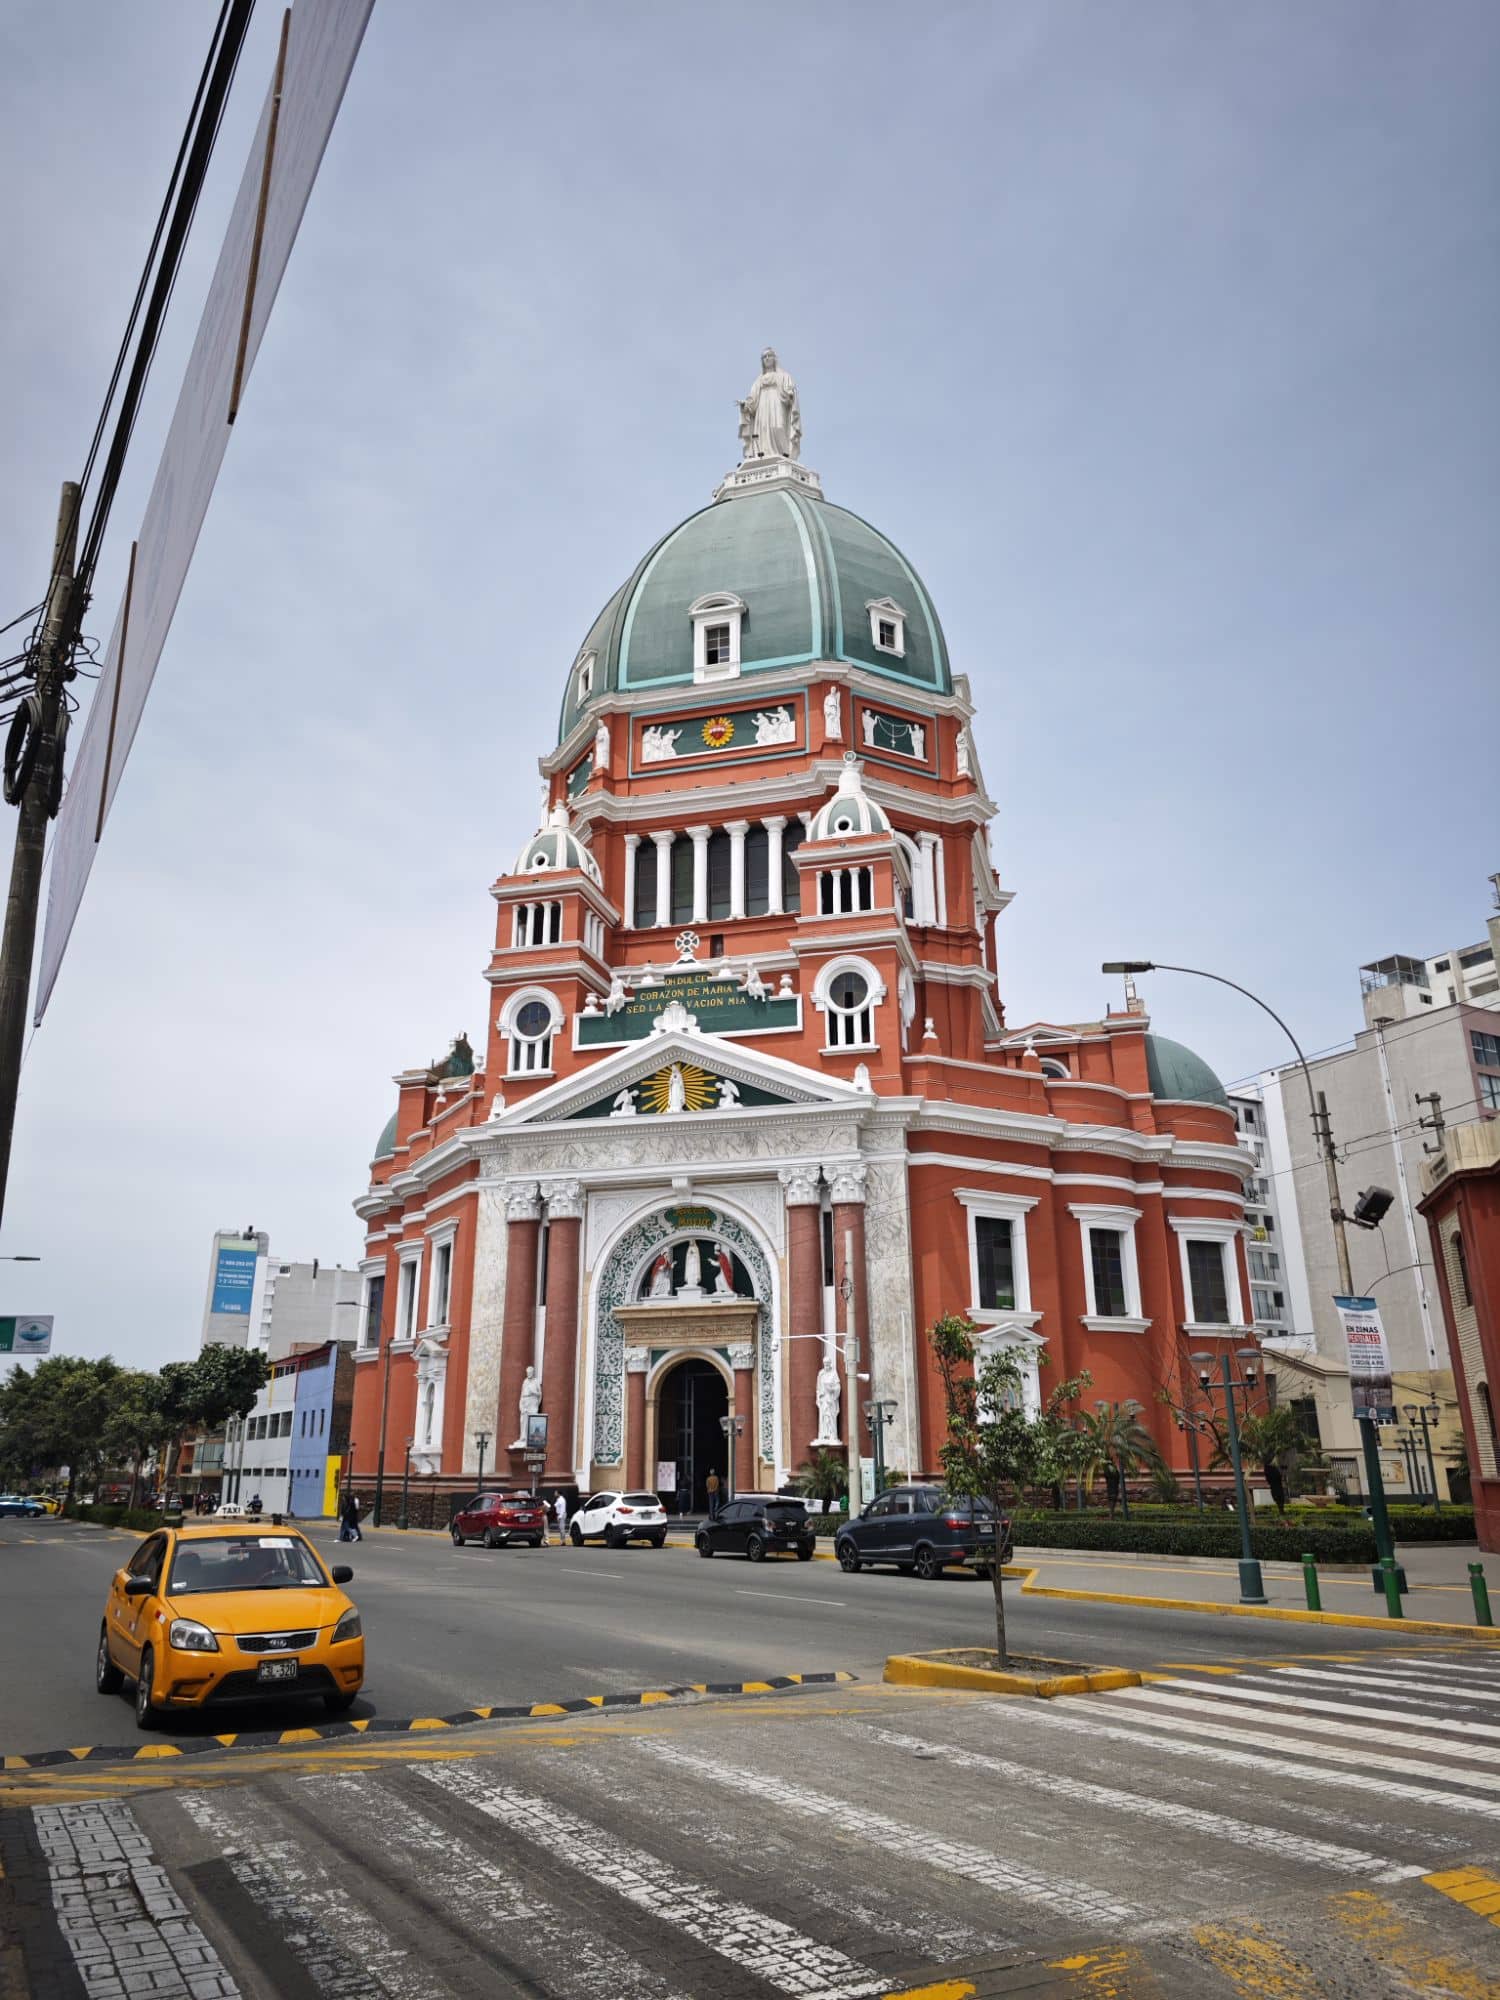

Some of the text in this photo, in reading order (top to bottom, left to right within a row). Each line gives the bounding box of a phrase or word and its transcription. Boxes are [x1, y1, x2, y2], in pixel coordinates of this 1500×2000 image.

[677, 975, 707, 985] DULCE
[640, 985, 733, 1001] CORAZON DE MARIA
[626, 997, 746, 1014] SED LA SVACION MIA
